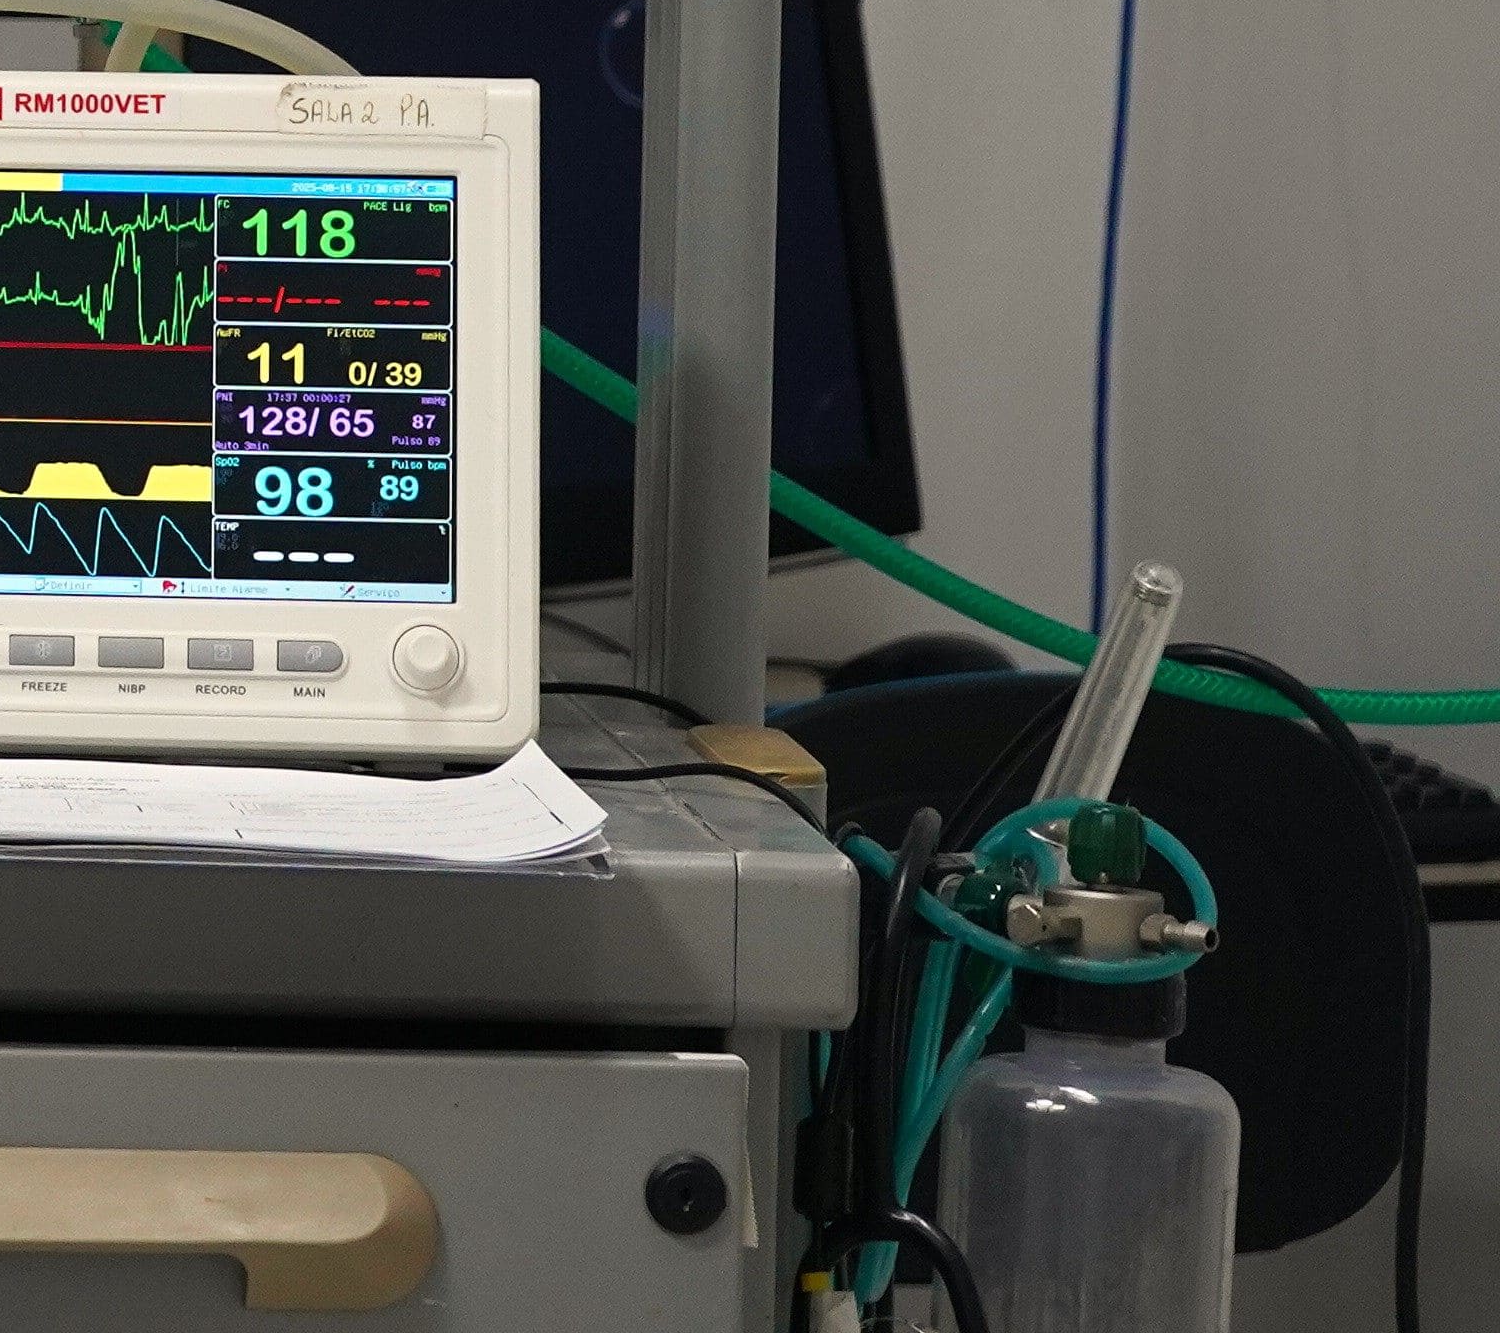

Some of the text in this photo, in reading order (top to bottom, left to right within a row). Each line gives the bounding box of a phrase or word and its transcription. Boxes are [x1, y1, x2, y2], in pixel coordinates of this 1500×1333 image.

[14, 93, 166, 115] RM1000VET
[289, 97, 356, 125] SALA
[361, 102, 379, 124] 2
[217, 199, 230, 209] FC
[363, 201, 387, 212] PACE
[243, 209, 356, 258] 118
[247, 342, 305, 384] 11
[385, 362, 422, 386] 39
[216, 393, 233, 402] PNI
[238, 405, 436, 437] 128/ 65 87
[392, 436, 422, 446] Pulso
[391, 460, 422, 470] Pulso
[428, 461, 447, 471] bpm
[255, 466, 334, 516] 98
[380, 475, 419, 501] 89
[21, 681, 68, 693] FREEZE
[118, 683, 146, 694] NIBP
[195, 684, 247, 696] RECORD
[293, 687, 326, 699] MAIN
